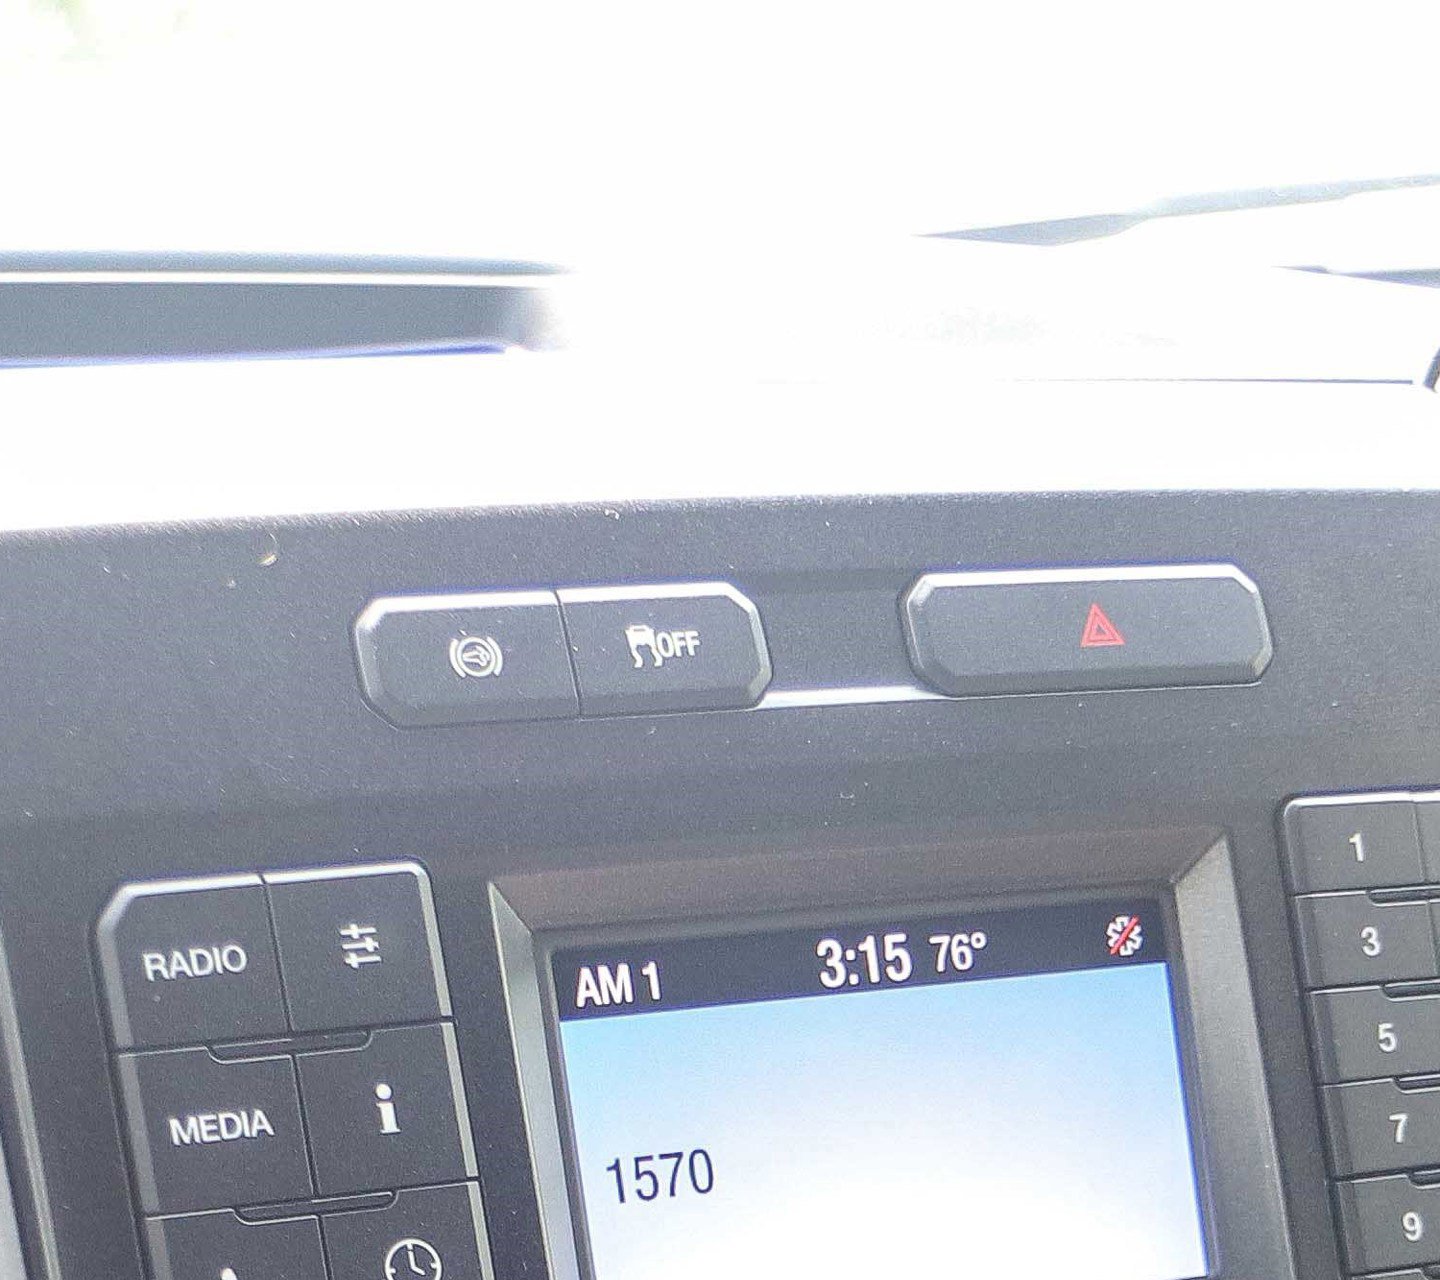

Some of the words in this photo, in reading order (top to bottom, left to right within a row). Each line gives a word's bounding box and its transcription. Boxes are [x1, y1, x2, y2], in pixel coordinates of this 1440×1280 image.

[657, 631, 701, 657] OFF
[1350, 834, 1366, 863] 1
[1362, 927, 1382, 957] 3
[143, 945, 248, 982] RADIO
[816, 932, 913, 988] 3:15
[930, 932, 988, 973] 76°
[577, 967, 634, 1008] AM
[643, 962, 661, 1001] 1
[1379, 1023, 1399, 1053] 5
[169, 1109, 275, 1146] MEDIA
[1390, 1114, 1409, 1144] 7
[607, 1149, 715, 1205] 1570
[1403, 1212, 1424, 1242] 9
